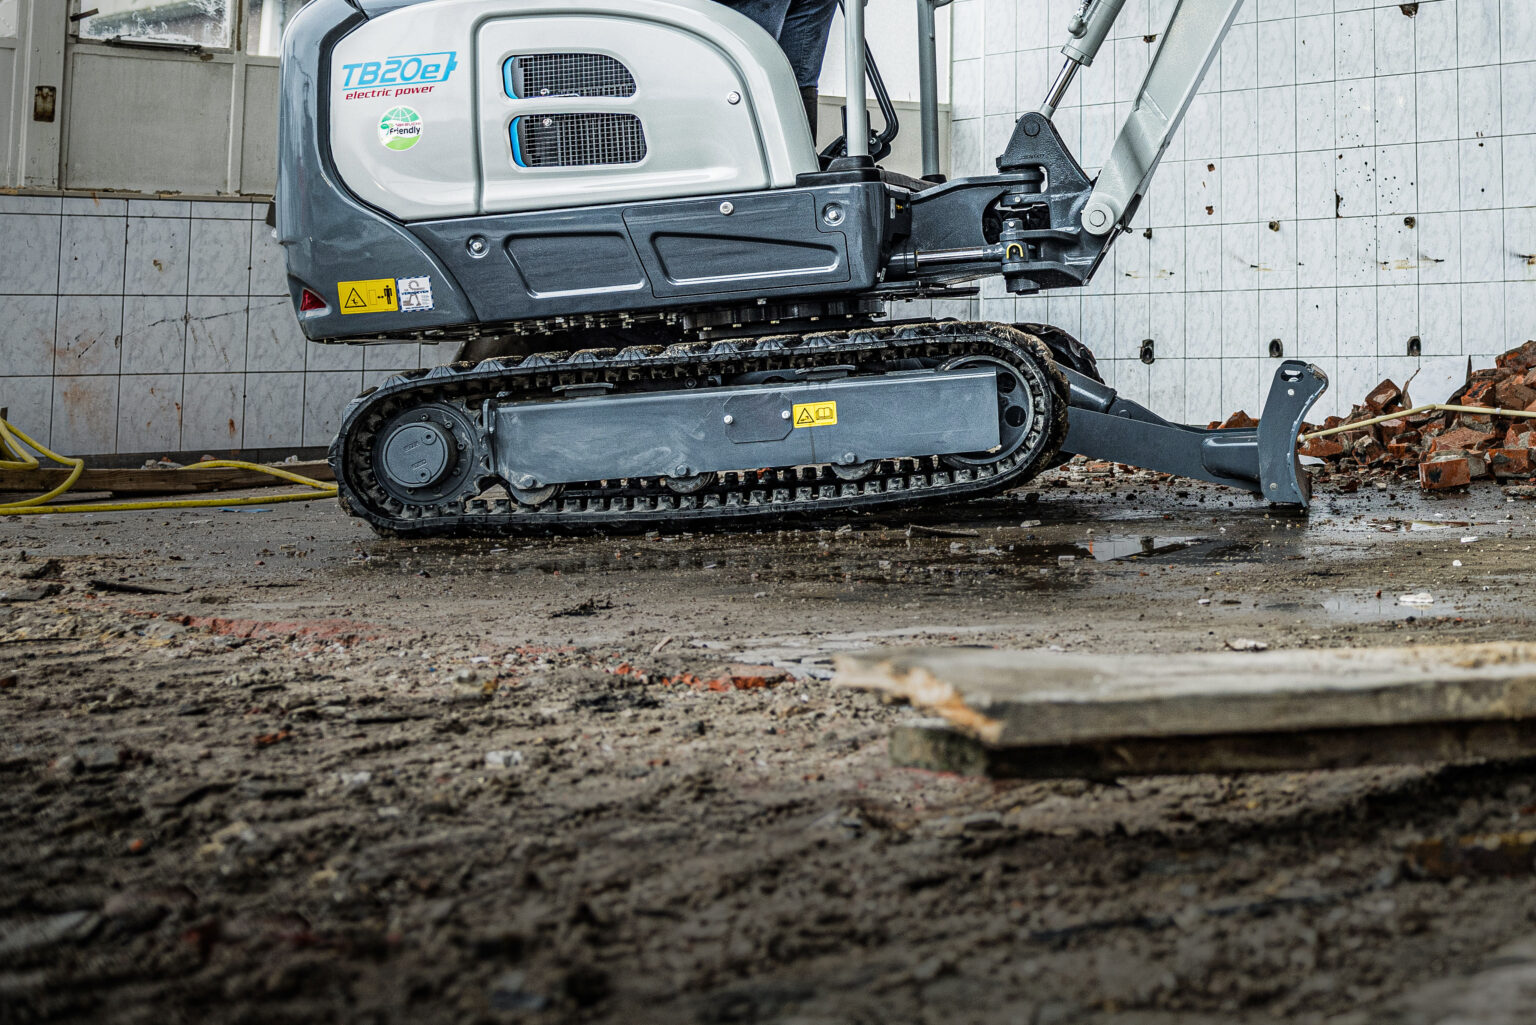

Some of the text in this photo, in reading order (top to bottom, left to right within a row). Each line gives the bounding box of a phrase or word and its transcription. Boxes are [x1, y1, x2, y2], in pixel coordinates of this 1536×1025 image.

[342, 57, 441, 87] TB20e
[345, 85, 435, 100] electric power
